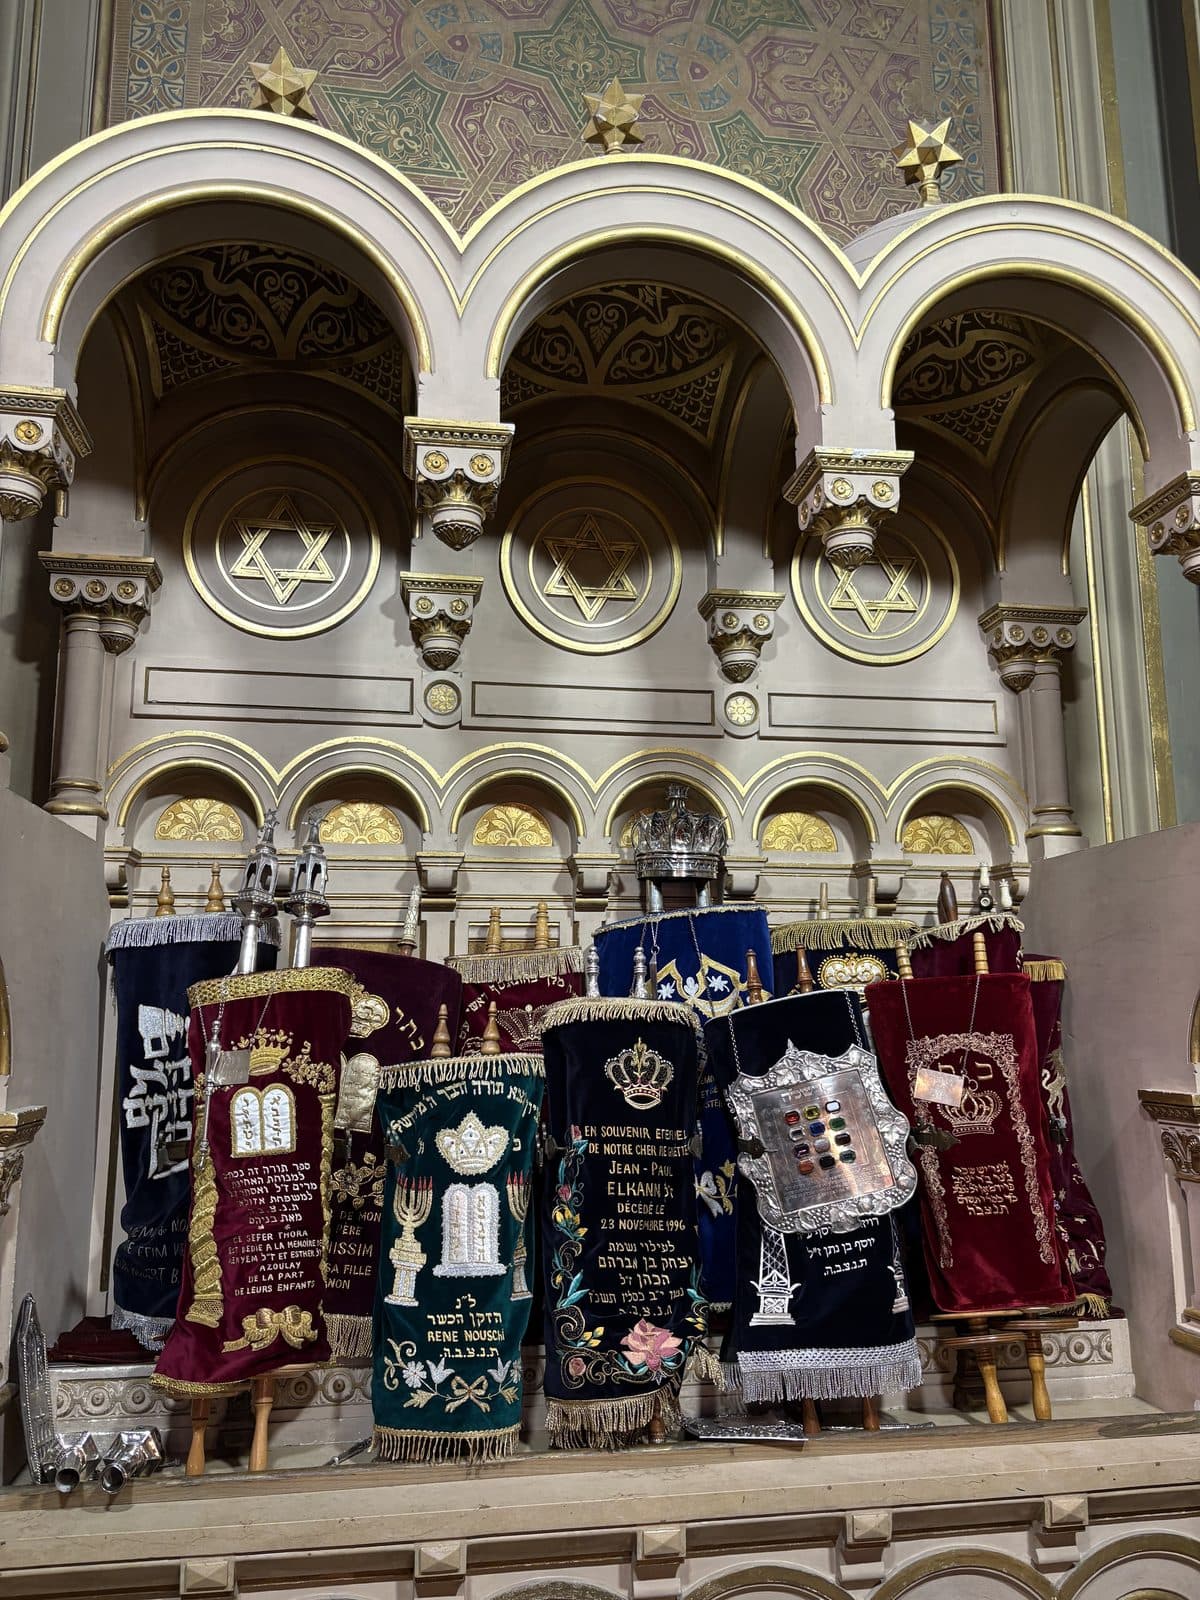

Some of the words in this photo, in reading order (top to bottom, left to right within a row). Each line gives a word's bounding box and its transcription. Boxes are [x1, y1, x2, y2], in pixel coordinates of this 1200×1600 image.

[471, 1080, 505, 1096] תורה
[584, 1125, 597, 1137] EN
[601, 1126, 652, 1140] SOUVENIR
[588, 1142, 600, 1154] DE
[603, 1143, 633, 1156] NOTRE
[635, 1144, 657, 1157] CHER
[247, 1167, 259, 1177] זה
[262, 1164, 289, 1175] תורה
[292, 1162, 311, 1171] ספר
[266, 1171, 305, 1184] למנוחת
[292, 1182, 318, 1191] מרים
[607, 1181, 662, 1198] ELKANN
[269, 1190, 313, 1204] למשפחת
[655, 1204, 666, 1215] LE
[280, 1213, 303, 1223] מאת
[359, 1211, 382, 1223] MON
[600, 1218, 616, 1230] 23
[618, 1219, 665, 1232] NOVEMBRE
[666, 1219, 687, 1232] 1996
[246, 1233, 274, 1242] SEFER
[278, 1229, 309, 1240] THORA
[274, 1241, 285, 1251] LA
[607, 1241, 638, 1253] נשמת
[822, 1244, 840, 1258] נתן
[841, 1242, 853, 1255] בן
[853, 1237, 876, 1252] יוסף
[278, 1251, 288, 1261] ET
[290, 1249, 315, 1260] ESTHER
[259, 1261, 301, 1272] AZOULAY
[598, 1255, 638, 1270] אברהם
[642, 1255, 658, 1273] בן
[660, 1255, 694, 1272] יצחק
[343, 1264, 372, 1276] FILLE
[248, 1275, 259, 1284] DE
[262, 1273, 274, 1282] LA
[278, 1271, 305, 1281] PART
[636, 1273, 671, 1289] הכהן
[235, 1287, 245, 1297] DE
[246, 1284, 273, 1295] LEURS
[277, 1279, 316, 1292] ENFANTS
[426, 1313, 464, 1326] הכשר
[469, 1312, 502, 1328] הזקן
[427, 1330, 459, 1342] RENE
